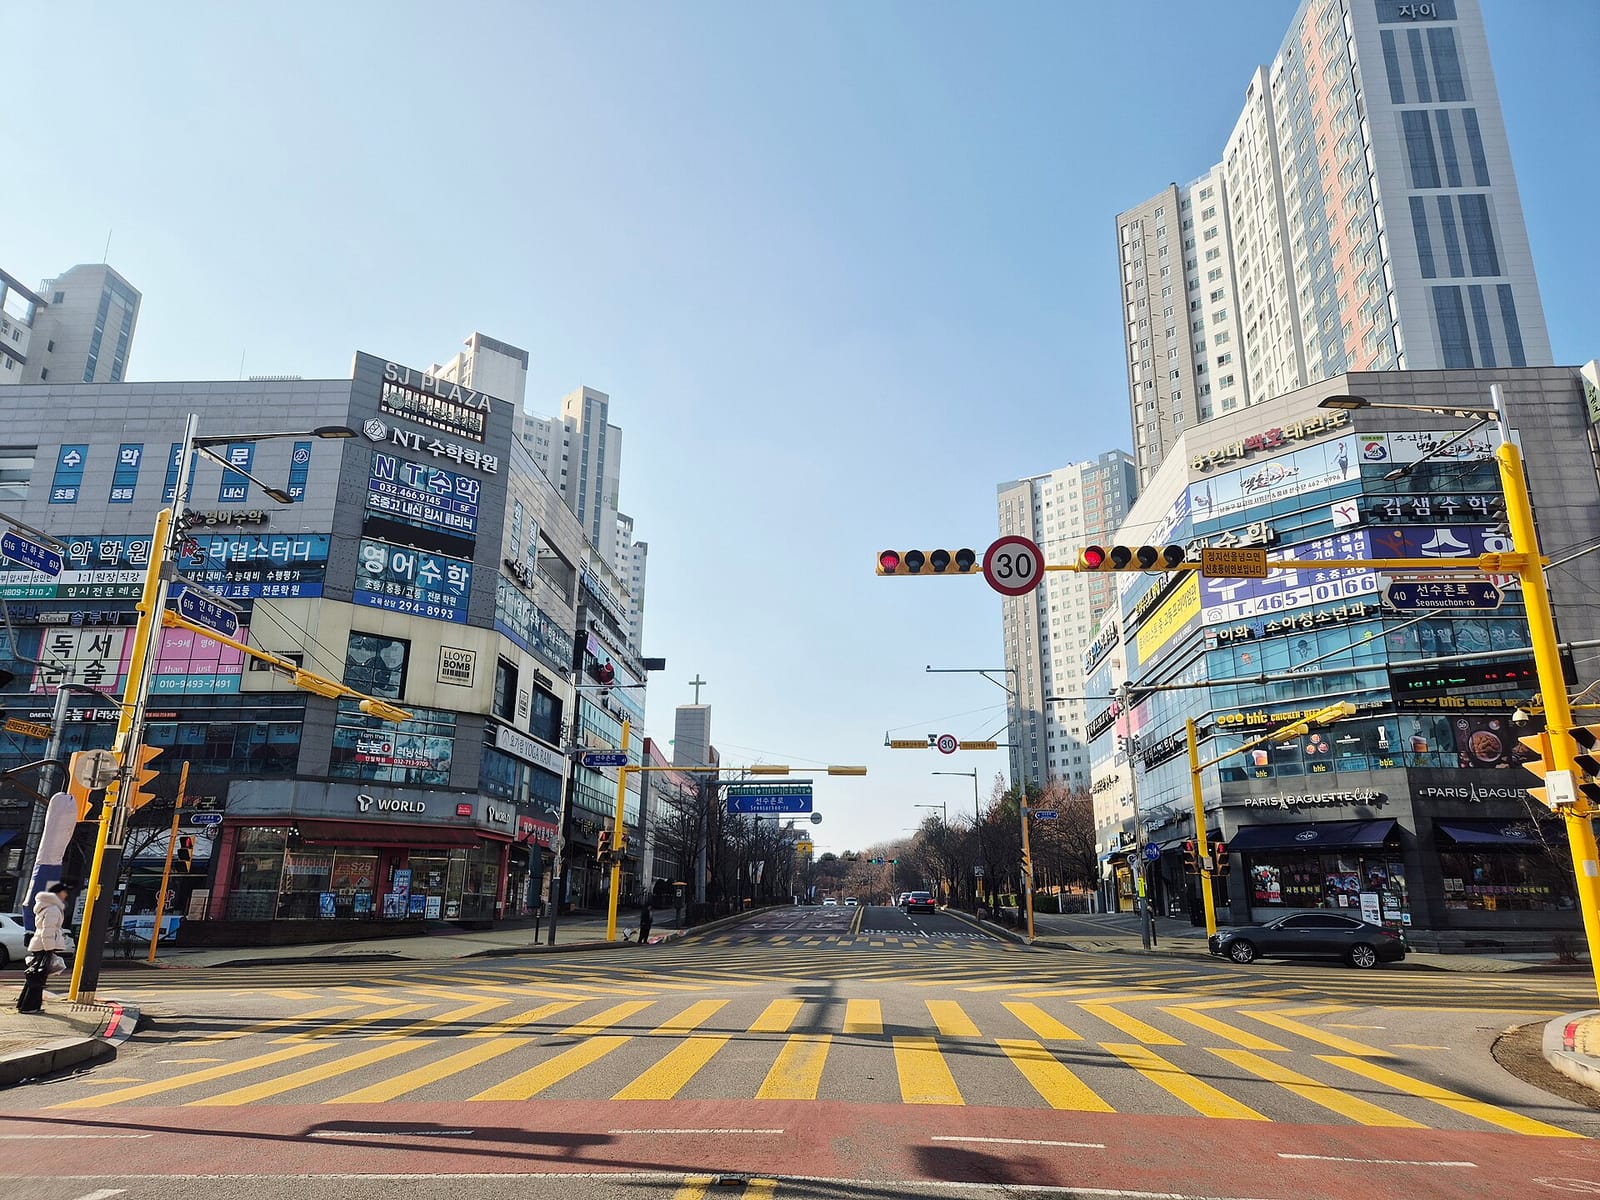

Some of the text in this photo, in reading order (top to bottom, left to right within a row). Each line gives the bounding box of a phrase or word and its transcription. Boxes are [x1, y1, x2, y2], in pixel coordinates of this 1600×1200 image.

[1399, 3, 1437, 18] 자이
[384, 362, 410, 386] SJ
[421, 375, 492, 413] PLAZA
[392, 427, 498, 474] NT 수학학원
[53, 488, 75, 499] 초등
[112, 488, 133, 499] 중등
[223, 488, 245, 499] 내신
[290, 487, 302, 497] 5F
[379, 482, 470, 513] 032.466.9145 5F
[370, 494, 400, 512] 초중고
[403, 500, 422, 517] 내신
[424, 508, 443, 523] 입시
[1382, 496, 1488, 516] 김샘수학
[3, 538, 59, 570] 616 인하로 612
[209, 541, 311, 562] 리얼스터디
[363, 545, 469, 592] 영어수학
[996, 553, 1032, 580] 30
[77, 573, 92, 582] 1:1
[96, 572, 116, 583] 원장
[119, 572, 140, 582] 직강
[266, 570, 300, 581] 수행평가
[1393, 584, 1496, 601] 40 선수촌로 44
[183, 598, 235, 631] 616 인하로 612
[398, 600, 454, 620] 294-8993
[51, 634, 112, 659] 독서
[444, 650, 472, 663] LLOYD
[443, 660, 471, 671] BOMB
[160, 679, 231, 688] 010-9493-7491
[1247, 710, 1268, 725] bhc
[941, 739, 954, 749] 30
[1256, 770, 1268, 778] bhc
[1313, 763, 1326, 772] bhc
[1244, 798, 1279, 808] PARIS
[1289, 791, 1353, 805] BAGUETTE
[1427, 787, 1467, 798] PARIS
[378, 799, 426, 813] WORLD
